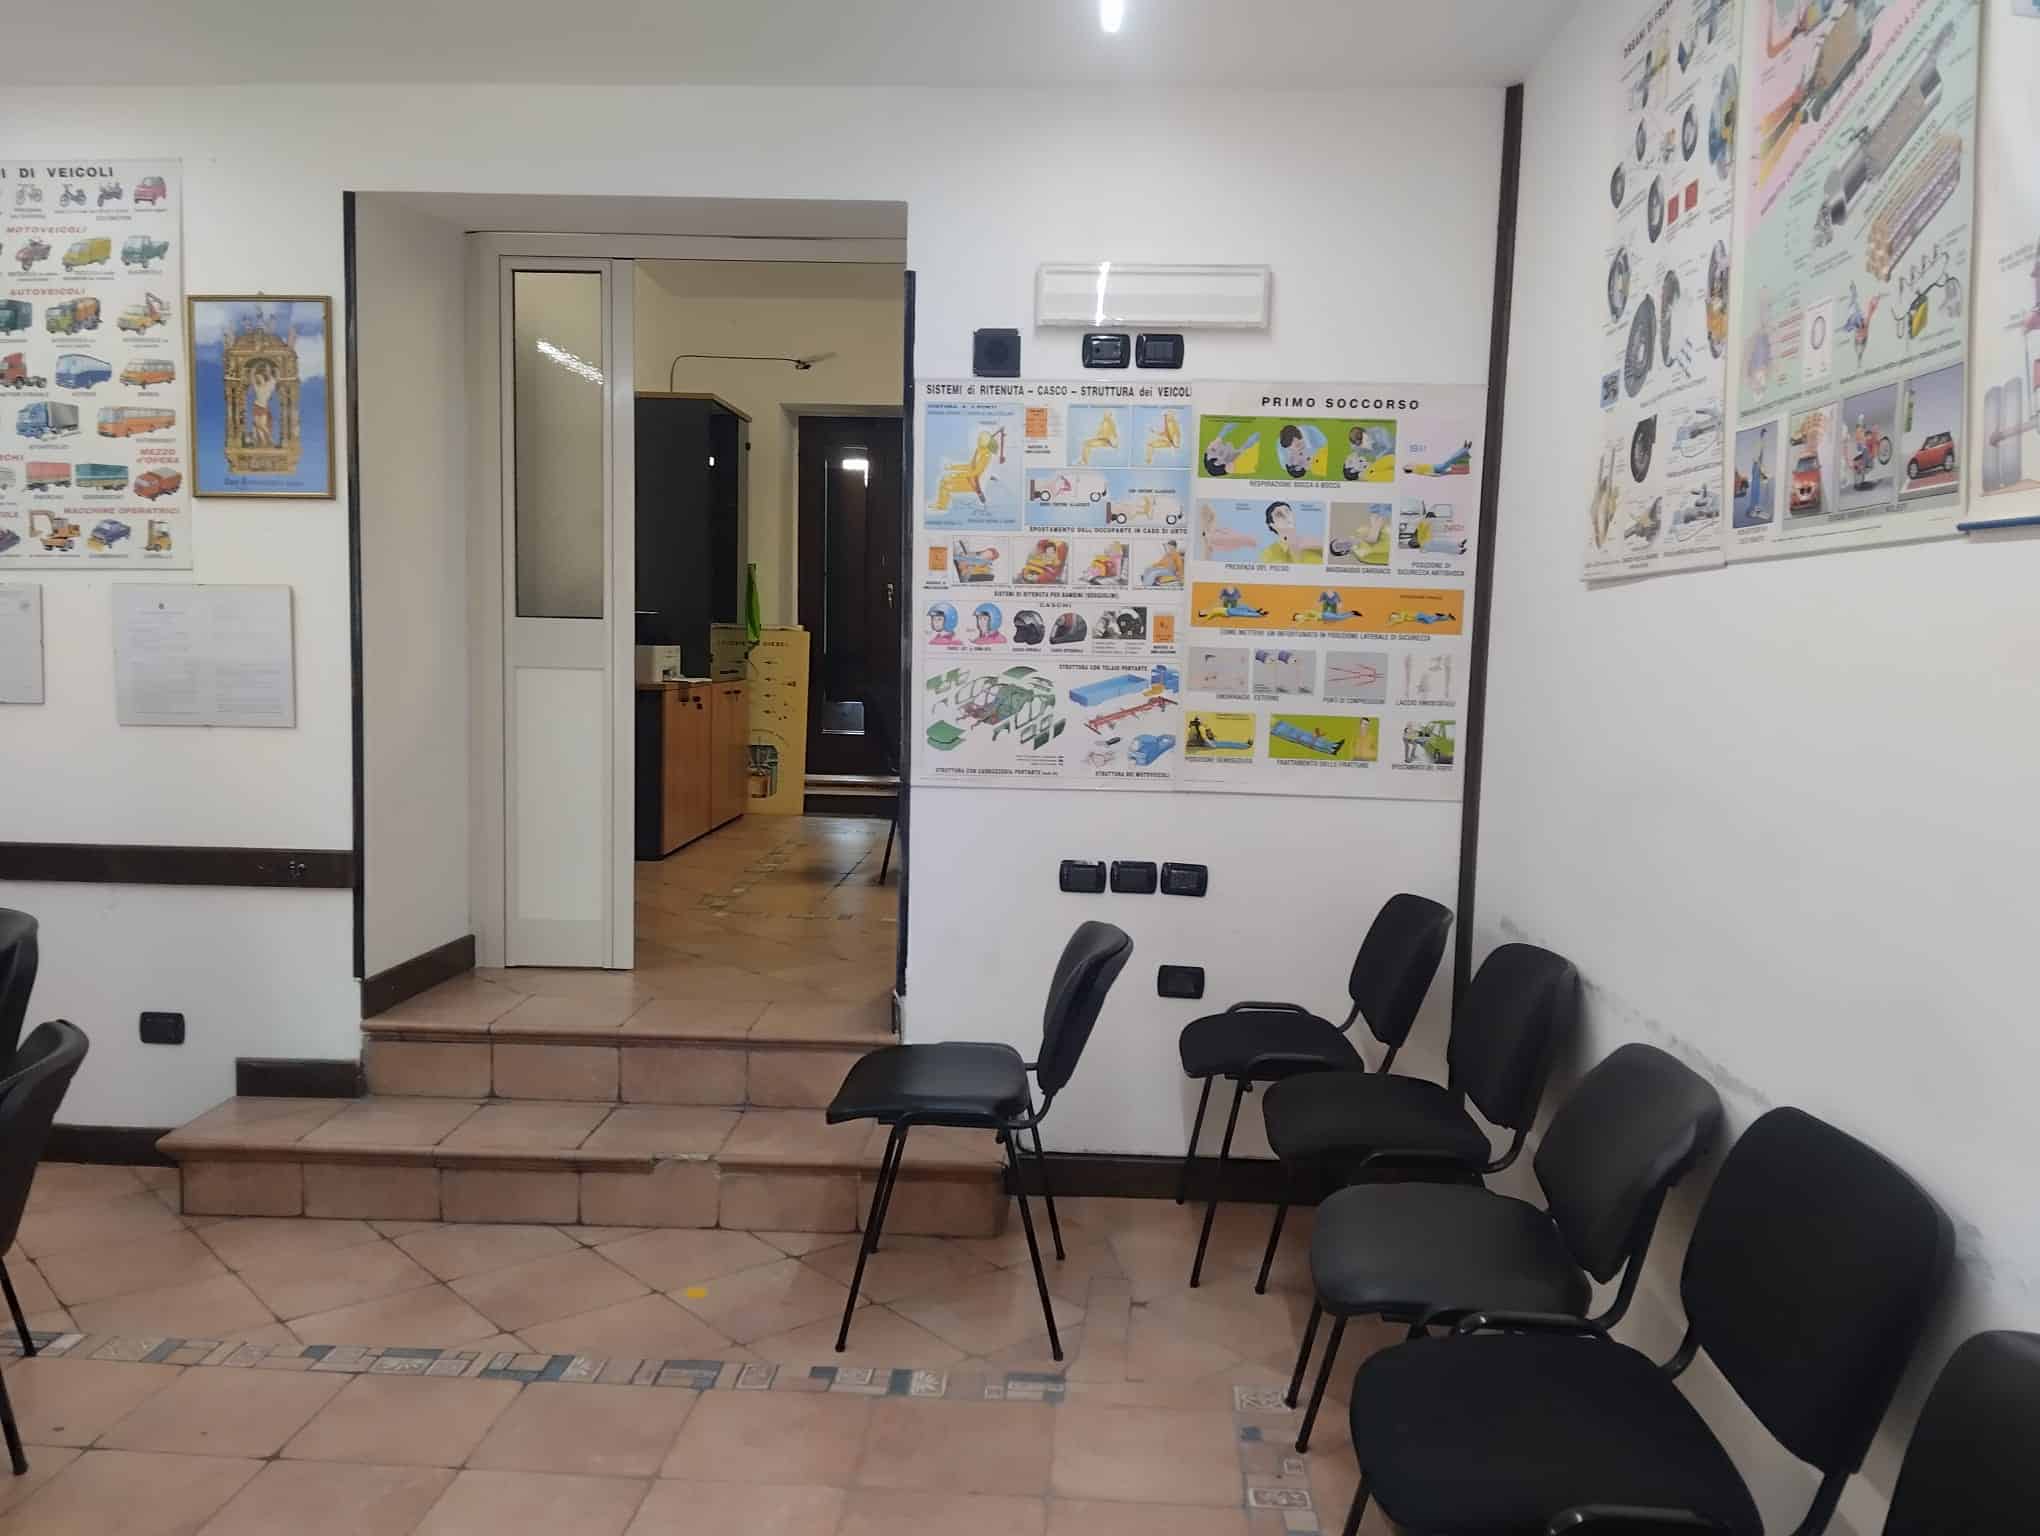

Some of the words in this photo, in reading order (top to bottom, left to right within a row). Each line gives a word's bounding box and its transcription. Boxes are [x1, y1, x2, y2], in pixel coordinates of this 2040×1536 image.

[18, 167, 35, 178] DI
[47, 166, 114, 178] VEICOLI
[6, 226, 87, 234] MOTOVEICOLI
[10, 287, 85, 296] AUTOVEICOLI
[926, 384, 962, 395] SISTEMI
[967, 385, 976, 395] di
[980, 385, 1024, 396] RITENUTA
[1037, 385, 1068, 396] CASCO
[1080, 386, 1135, 397] STRUTTURA
[1139, 386, 1153, 397] dei
[1261, 396, 1316, 408] PRIMO
[1325, 398, 1420, 410] SOCCORSO
